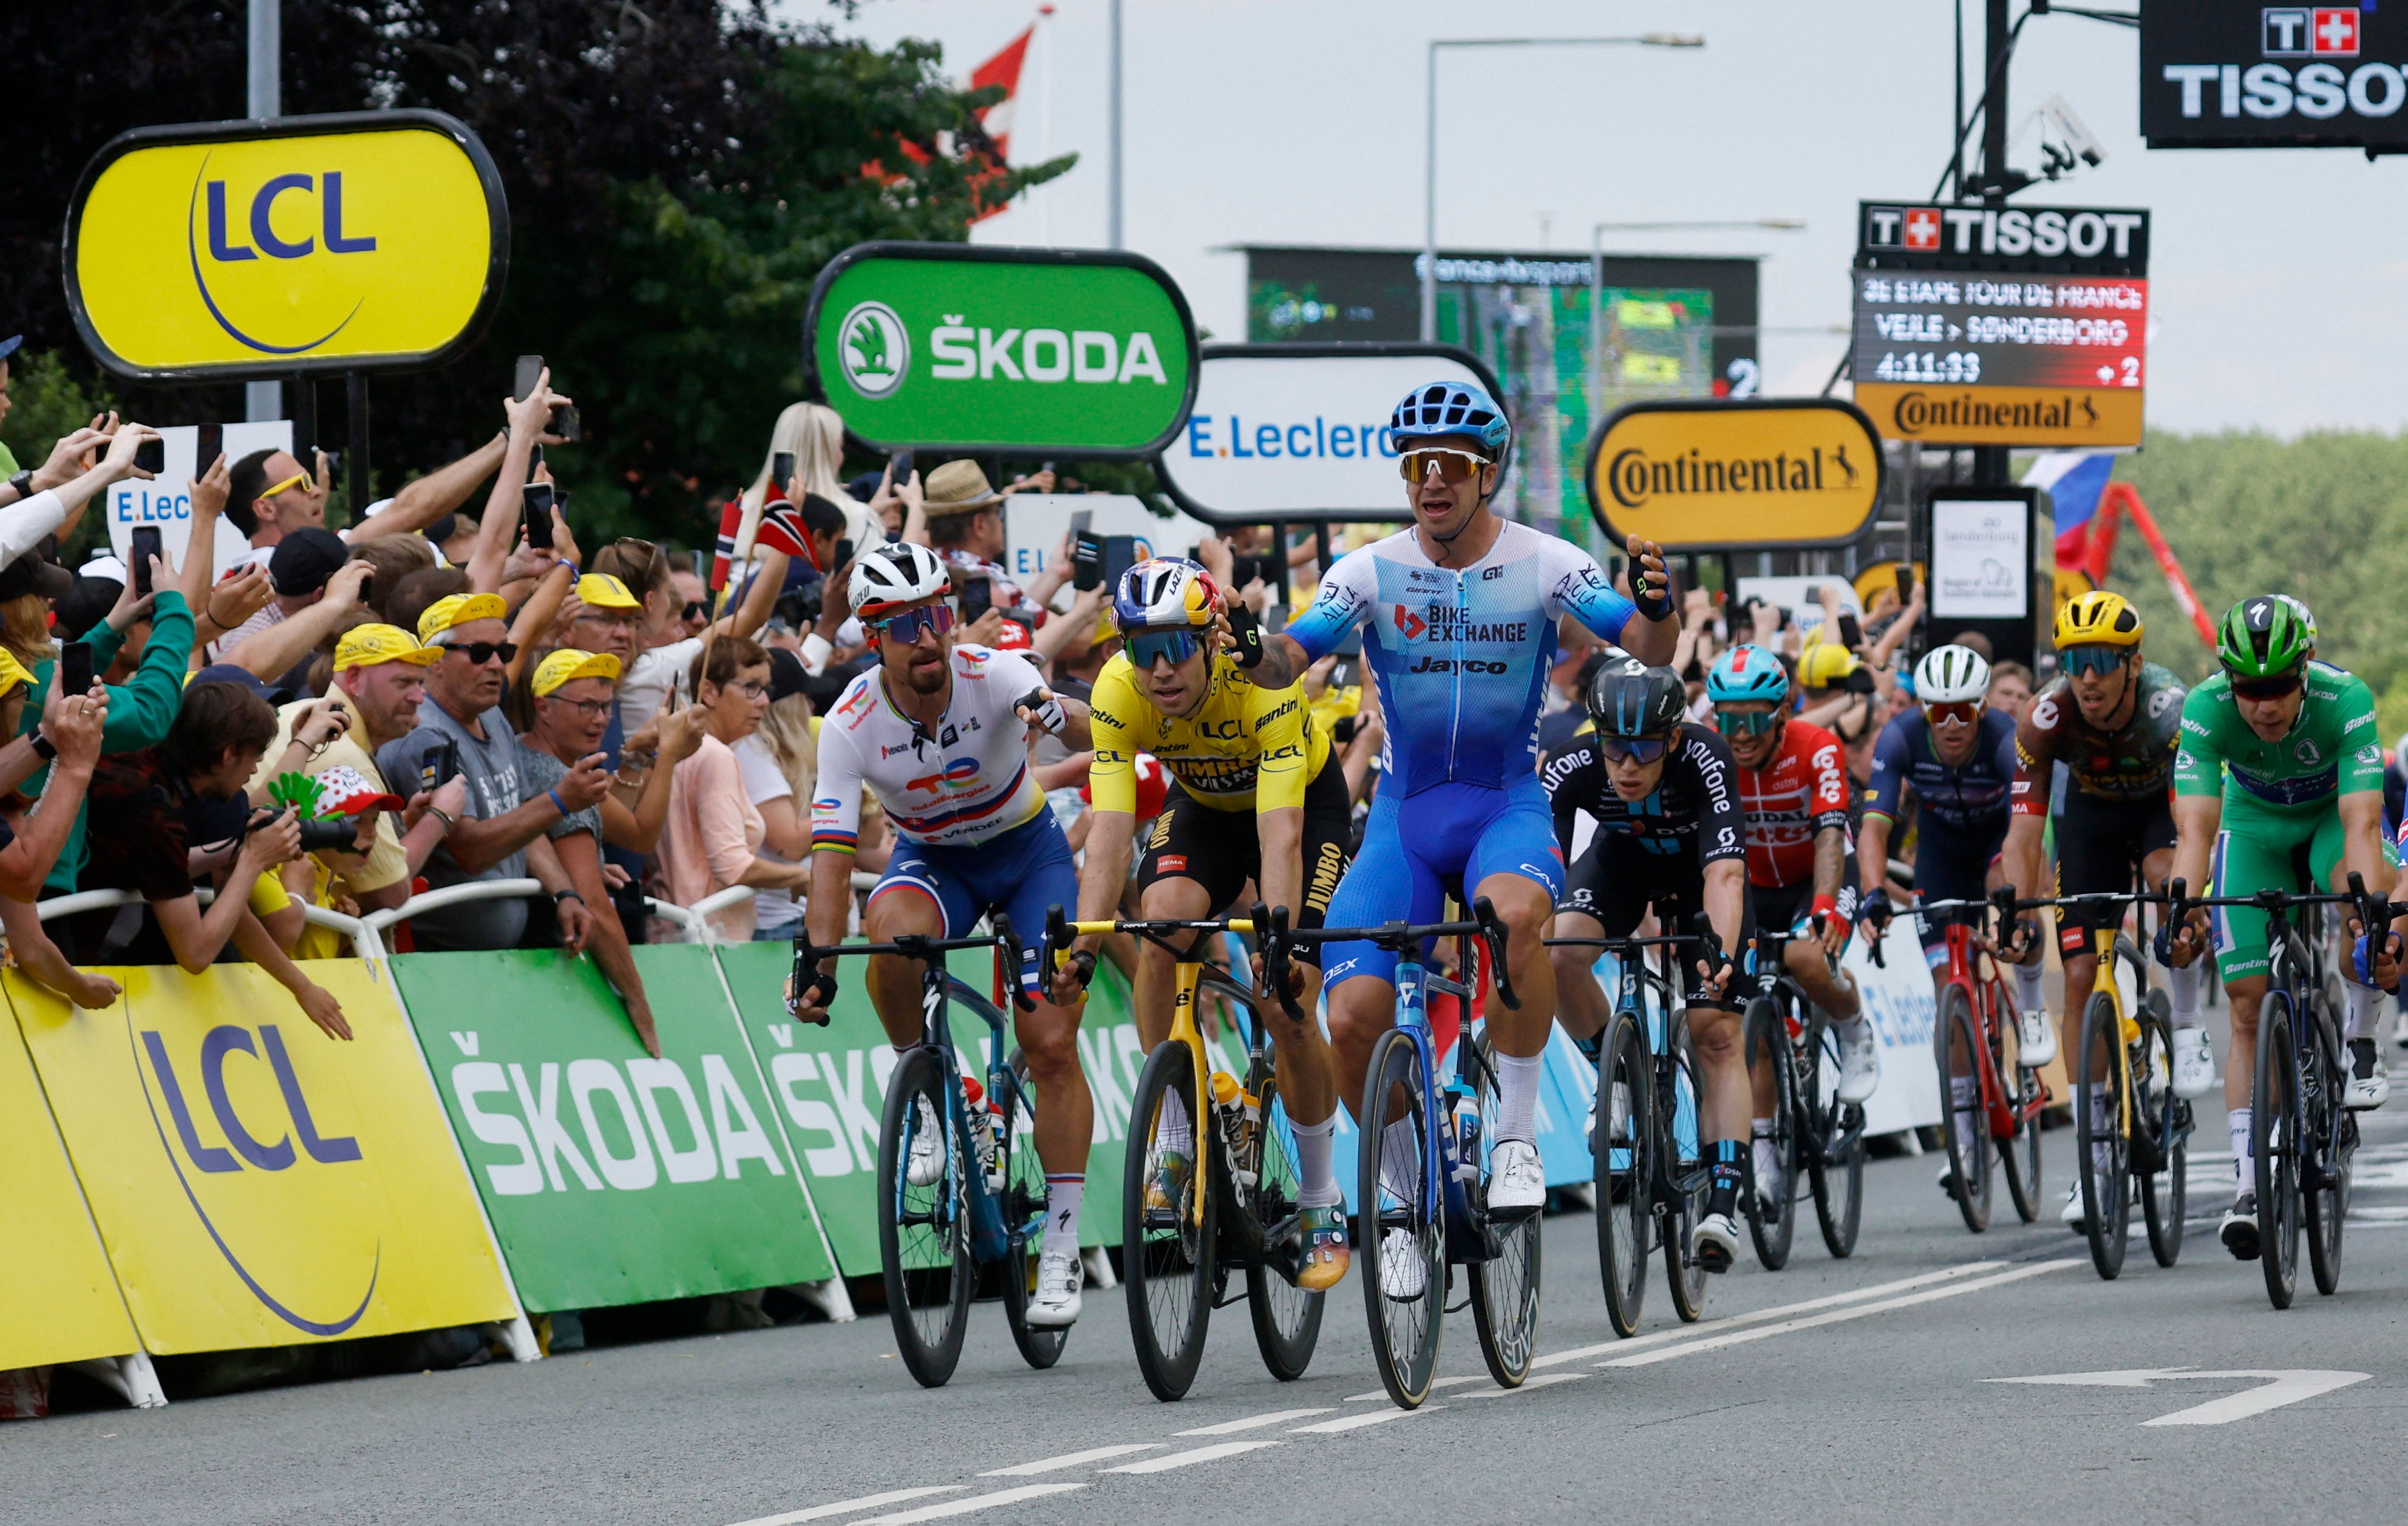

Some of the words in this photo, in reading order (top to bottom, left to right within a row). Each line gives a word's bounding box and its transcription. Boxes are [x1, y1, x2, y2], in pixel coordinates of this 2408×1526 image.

[2164, 62, 2408, 118] TISSO
[207, 171, 376, 262] LCL
[1945, 209, 2141, 257] TISSOT
[1863, 279, 1893, 303] 3E
[1894, 279, 1961, 305] ETAPE
[1965, 280, 2021, 307] TOUR
[2024, 284, 2053, 308] DE
[2056, 284, 2142, 310] FRANCE
[1966, 315, 2128, 347] SØNDERBORG
[930, 314, 1167, 384] ŠKODA
[1875, 351, 1981, 383] 4:11:33
[1895, 392, 2072, 434] Continental
[1609, 448, 1823, 508] Continental
[1120, 572, 1128, 602] LAZER
[1169, 564, 1185, 596] LAZER
[1428, 605, 1470, 624] BIKE
[1428, 622, 1527, 642] EXCHANGE
[1410, 656, 1508, 676] Jayco
[848, 698, 879, 732] TotalEnergies
[1255, 695, 1298, 732] Santini
[1202, 720, 1248, 740] LCL
[1264, 745, 1304, 762] LCL
[1681, 738, 1731, 814] youfone
[910, 783, 991, 812] TotalEnergies
[942, 816, 1004, 839] VENDÉE
[1705, 846, 1745, 859] SCOTT
[1305, 842, 1342, 916] JUMBO
[1520, 863, 1560, 905] CAD
[1557, 901, 1605, 916] SCOTT
[2063, 934, 2082, 943] HEMA
[141, 1024, 363, 1173] LCL
[449, 1030, 786, 1196] ŠKODA
[1725, 1167, 1742, 1178] DSM
